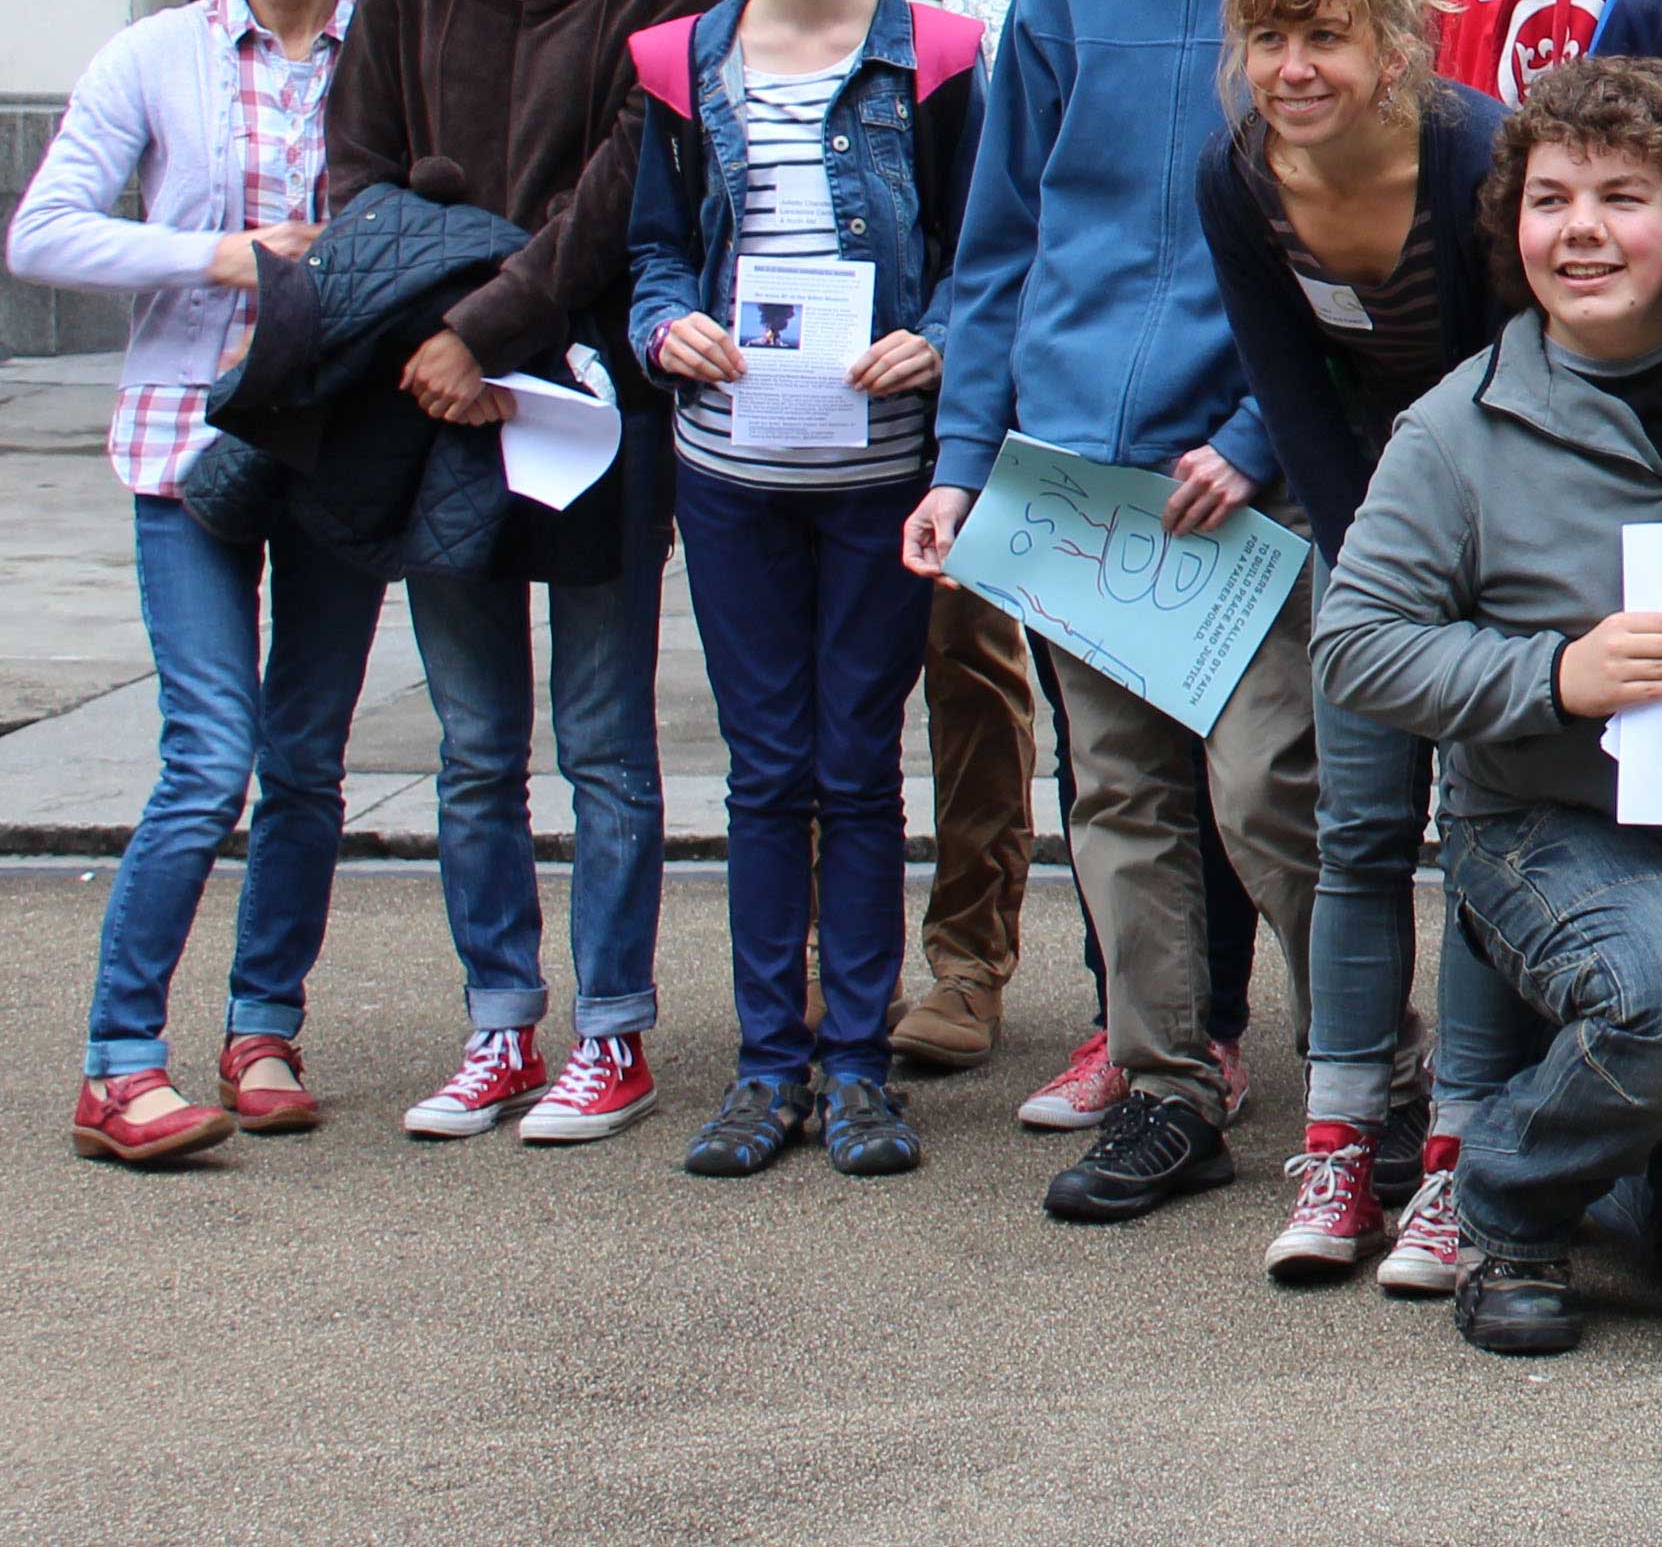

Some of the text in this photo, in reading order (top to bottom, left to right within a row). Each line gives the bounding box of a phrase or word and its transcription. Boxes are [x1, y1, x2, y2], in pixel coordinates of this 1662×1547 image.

[1216, 563, 1242, 604] FAIRER
[1245, 533, 1259, 554] FOR
[1182, 542, 1271, 691] TO BUILD PEACE AND JUSTICE
[1188, 549, 1282, 707] QUAKERS ARE CALLED BY FAITH
